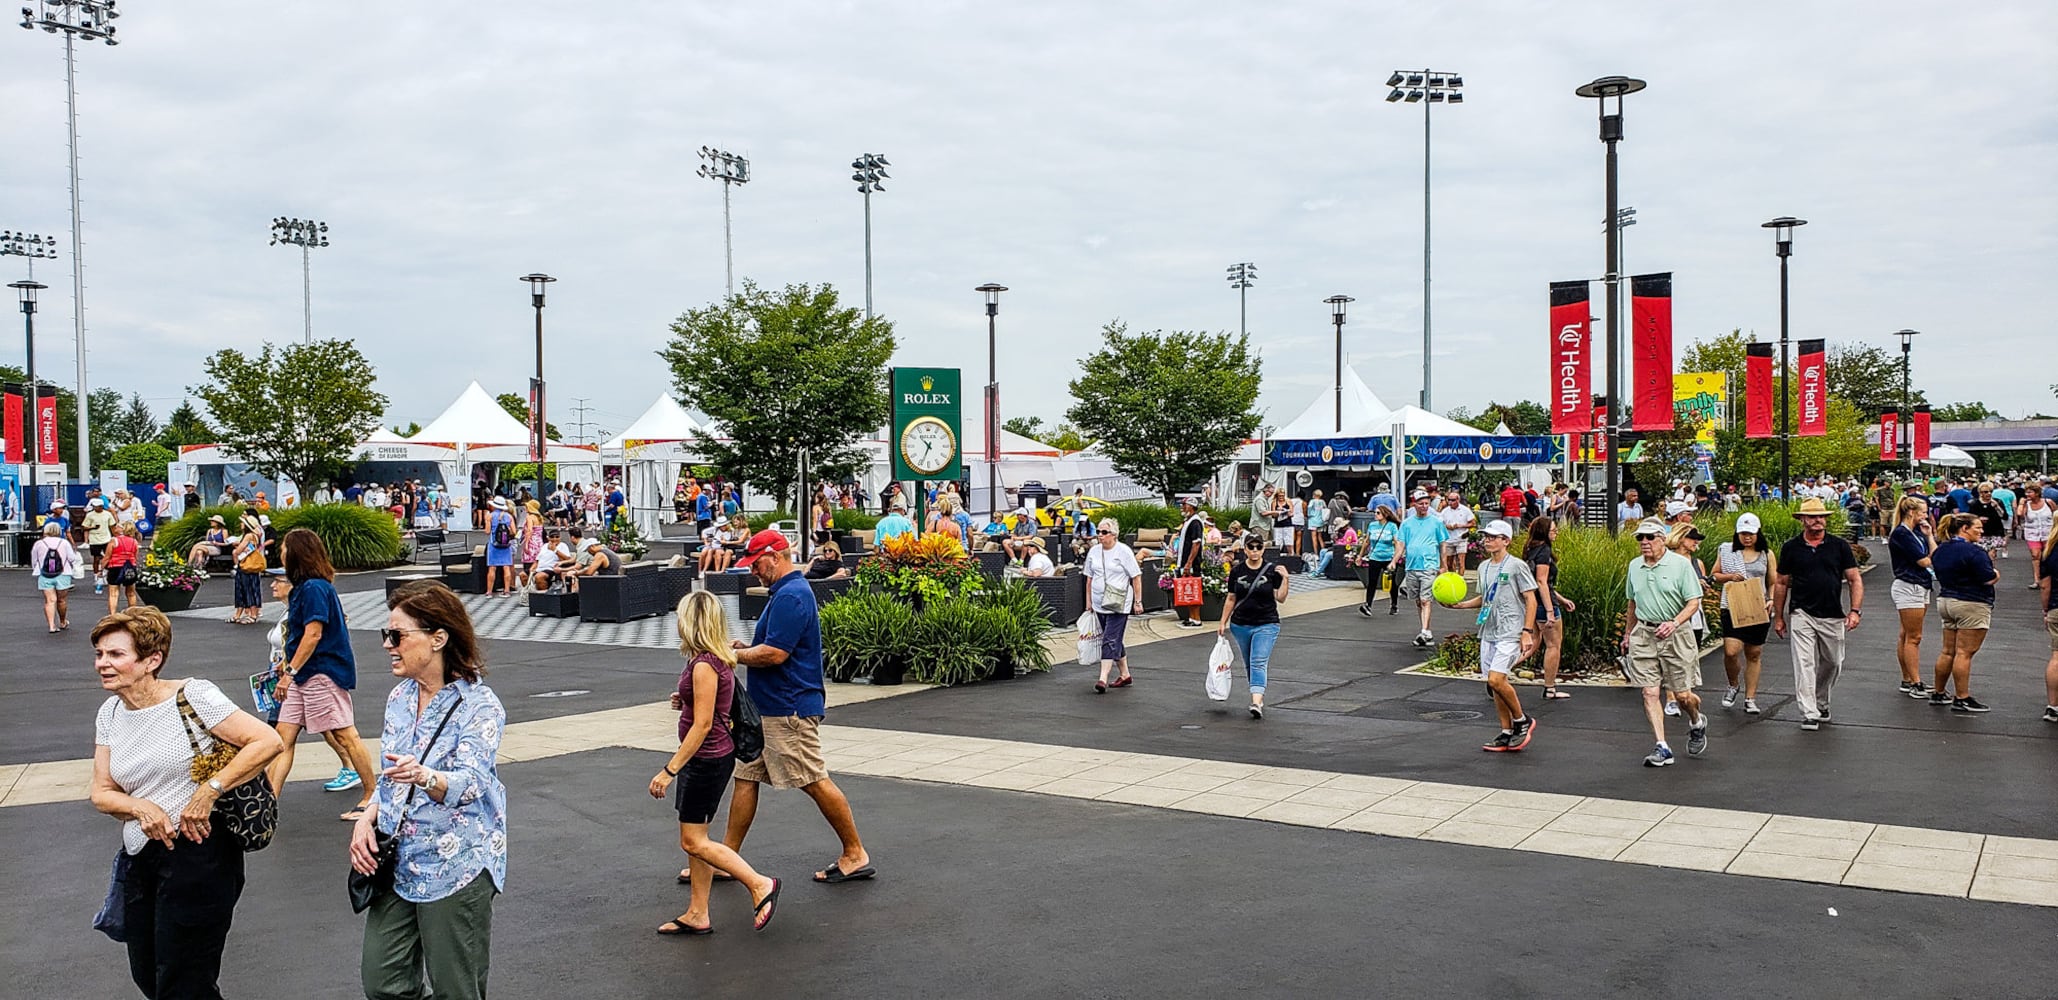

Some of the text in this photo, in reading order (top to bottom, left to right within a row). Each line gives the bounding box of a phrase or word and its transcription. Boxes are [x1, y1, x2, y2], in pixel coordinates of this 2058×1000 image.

[904, 393, 951, 404] ROLEX
[1561, 351, 1581, 413] Health
[1805, 383, 1819, 423] Health
[43, 421, 54, 454] Health
[1282, 451, 1320, 459] TOURNAMENT
[1334, 449, 1374, 457] INFORMATION
